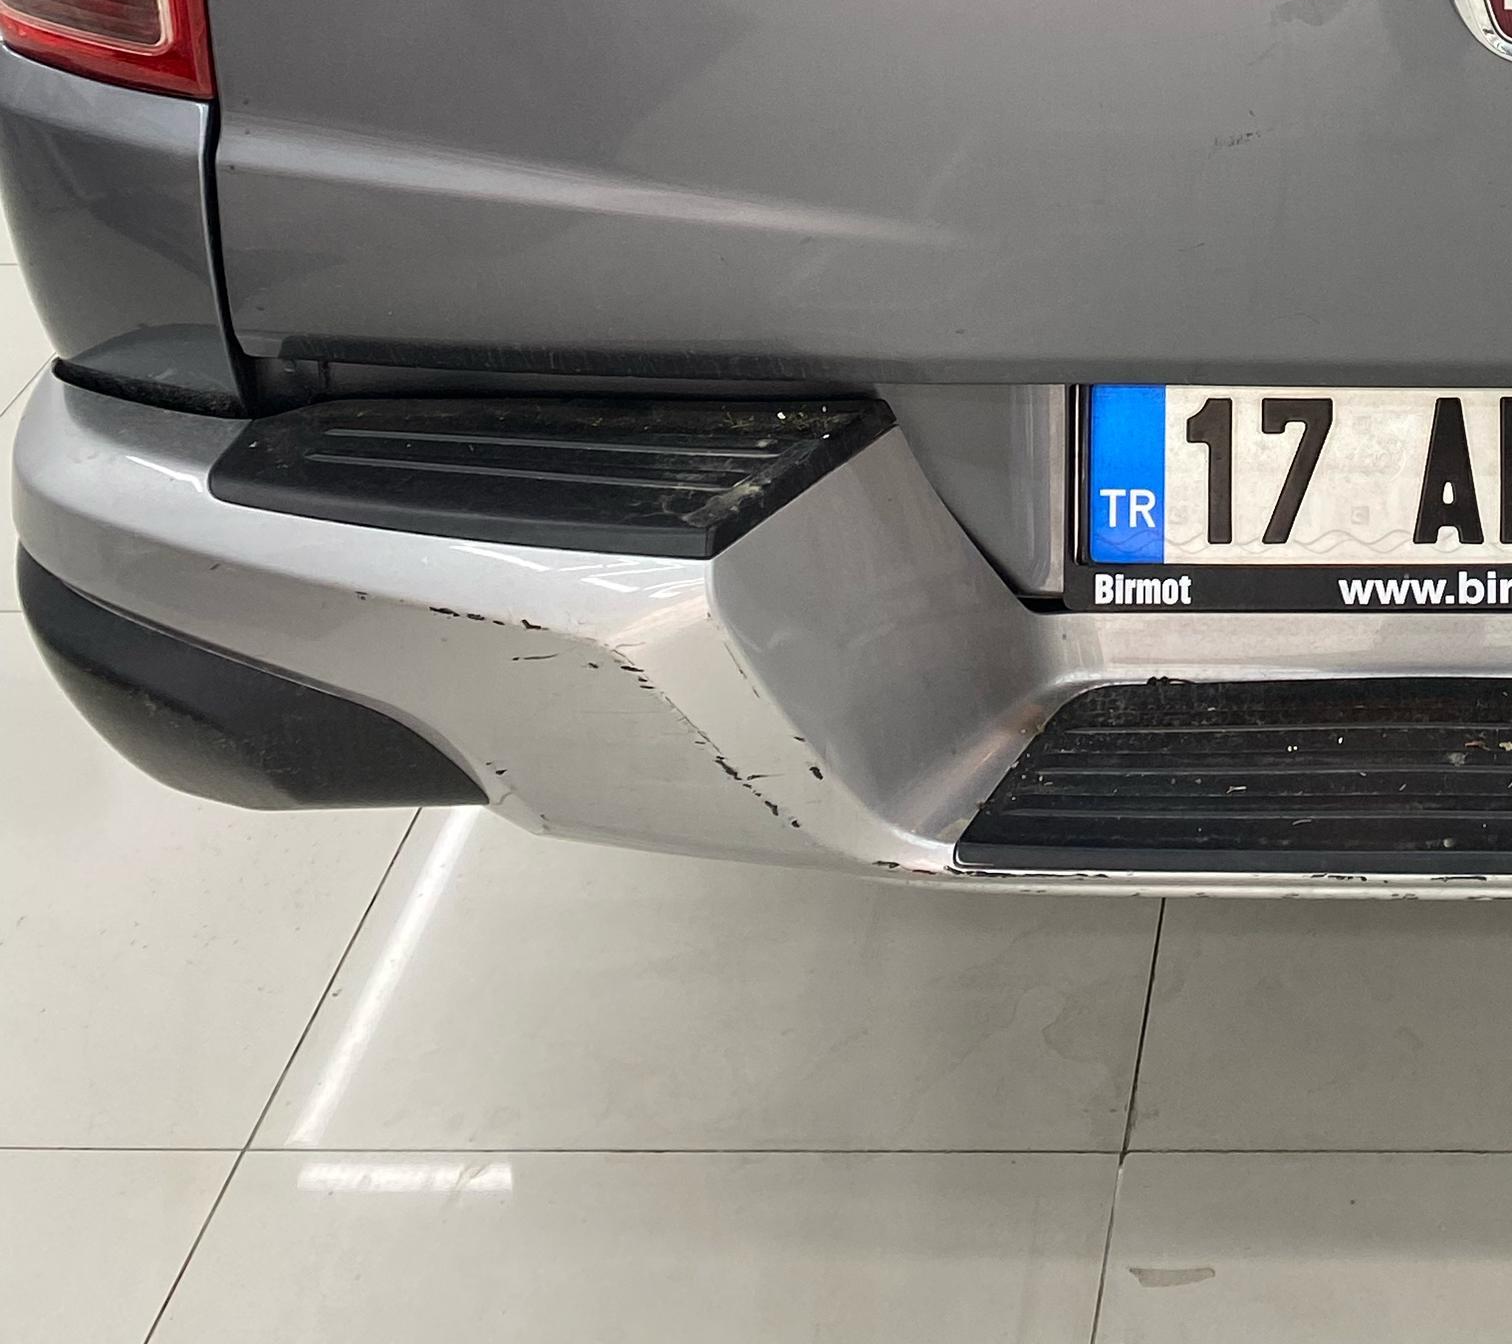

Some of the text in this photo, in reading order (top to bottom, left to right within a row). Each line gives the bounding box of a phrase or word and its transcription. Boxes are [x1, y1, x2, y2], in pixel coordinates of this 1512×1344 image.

[1186, 397, 1333, 545] 17
[1099, 489, 1156, 528] TR
[1094, 573, 1192, 605] Birmot
